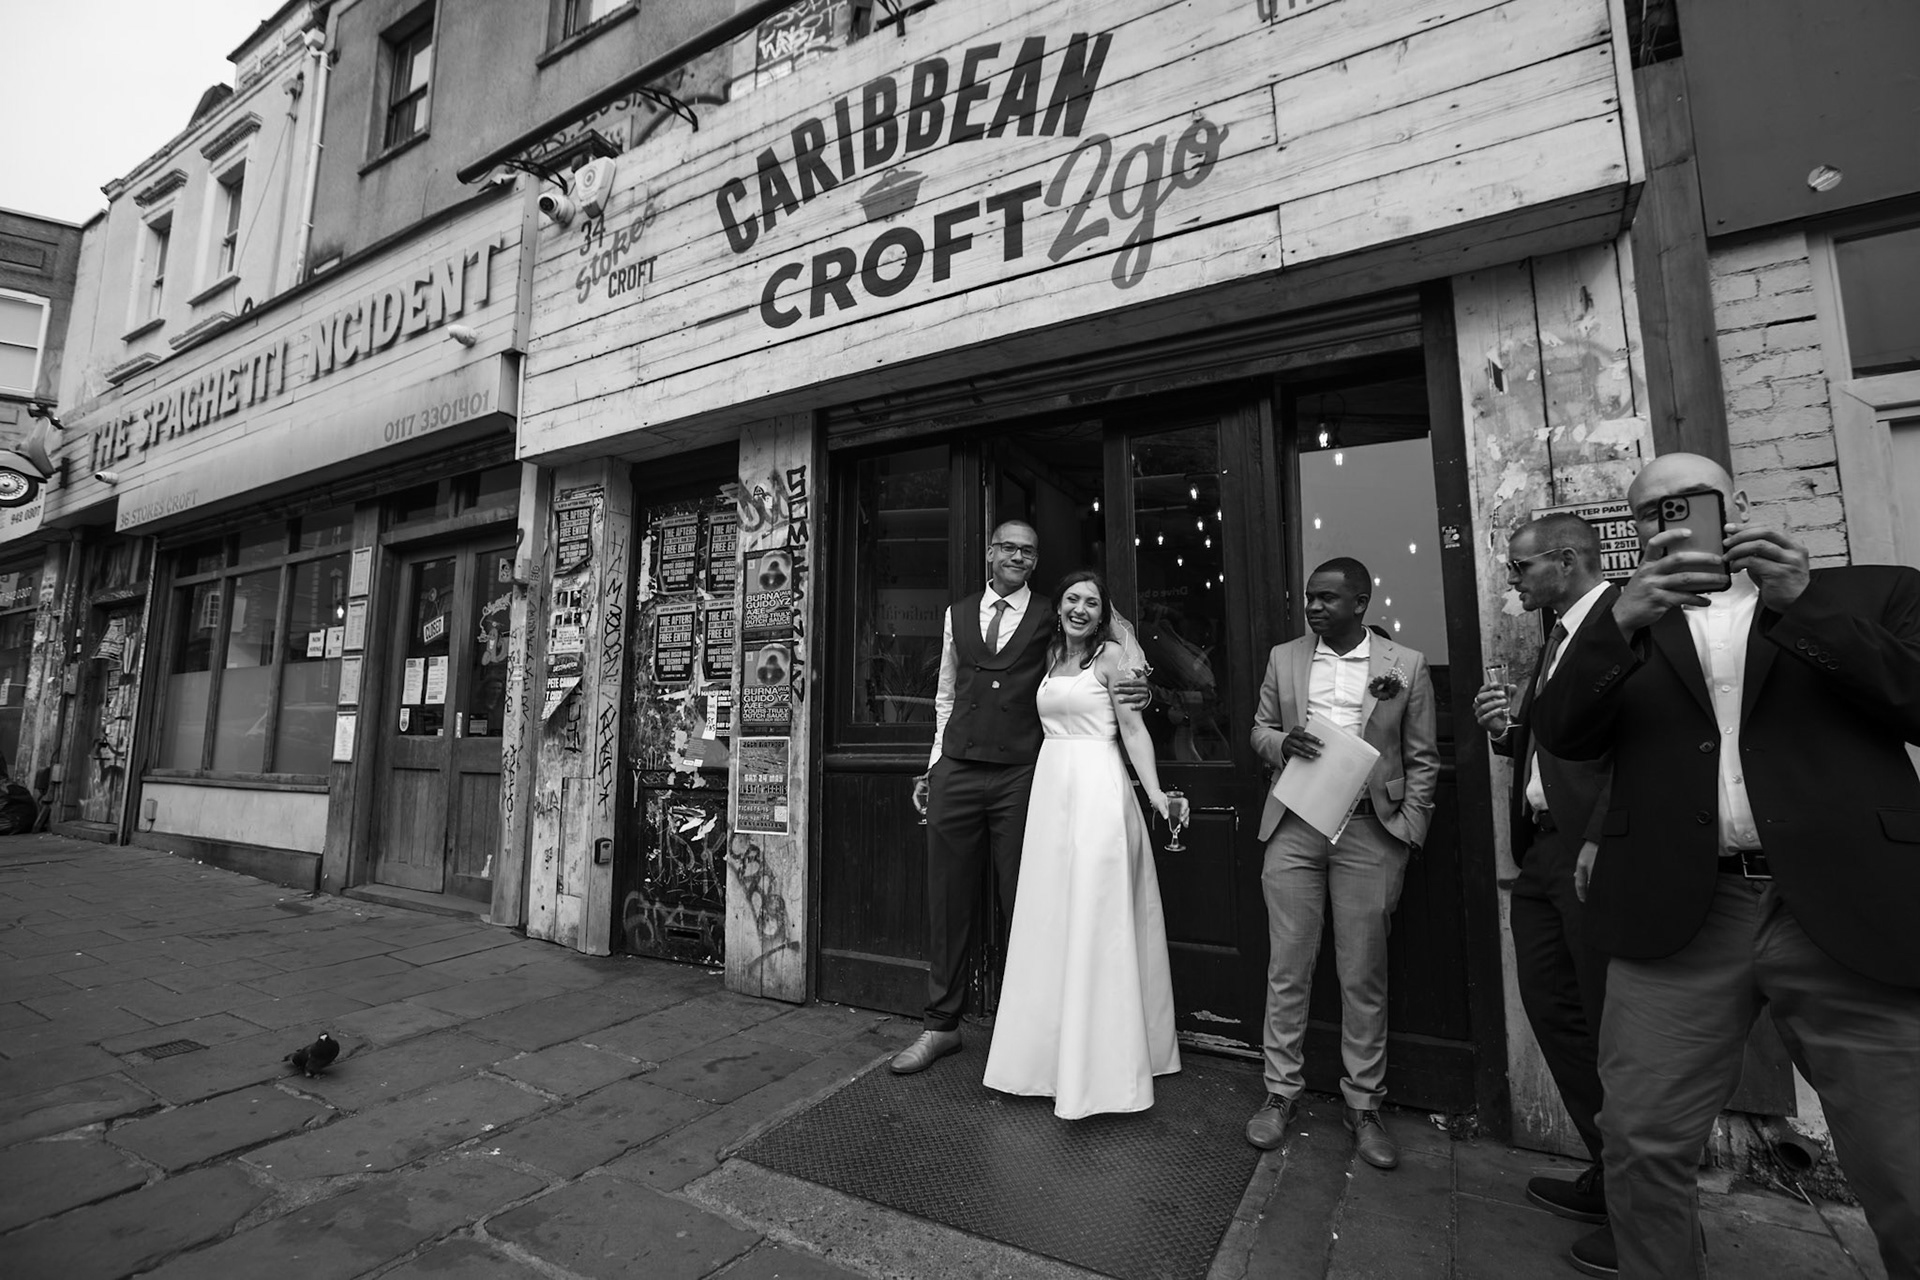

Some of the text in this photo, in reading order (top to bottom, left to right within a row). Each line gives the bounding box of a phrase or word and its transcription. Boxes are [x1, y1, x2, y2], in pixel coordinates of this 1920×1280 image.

[716, 33, 1113, 253] CARIBBEAN
[760, 114, 1229, 329] CROFT 2go
[580, 213, 605, 256] 34
[576, 203, 657, 304] Stokes
[608, 256, 658, 298] CROFT
[86, 411, 136, 473] THE
[138, 340, 290, 452] SPAGHETTI
[384, 390, 489, 442] 0117 3301401
[131, 501, 164, 524] STOKES
[166, 489, 199, 513] CROFT
[1602, 504, 1629, 514] PART
[559, 509, 590, 521] THE AFTERS
[560, 527, 571, 538] FREE
[665, 526, 696, 538] THE AFTERS
[713, 524, 737, 535] THE AFT
[1591, 520, 1639, 540] TERS
[663, 542, 695, 555] FREE ENTRY
[712, 542, 726, 552] FREE
[1614, 540, 1637, 550] 25TH
[1601, 550, 1640, 570] NTRY
[745, 597, 791, 610] GUIDO YZ
[746, 592, 780, 603] BURNA
[660, 614, 692, 626] THE AFTERS
[708, 610, 733, 621] THE AFT
[769, 611, 790, 619] TRULY
[424, 619, 442, 640] CLOSED
[708, 629, 722, 639] FREE
[659, 632, 691, 643] FREE ENTRY
[547, 677, 560, 689] PETE
[743, 687, 778, 696] BURNA
[743, 693, 790, 703] GUIDO YZ
[744, 774, 783, 783] SAT 24 MAY
